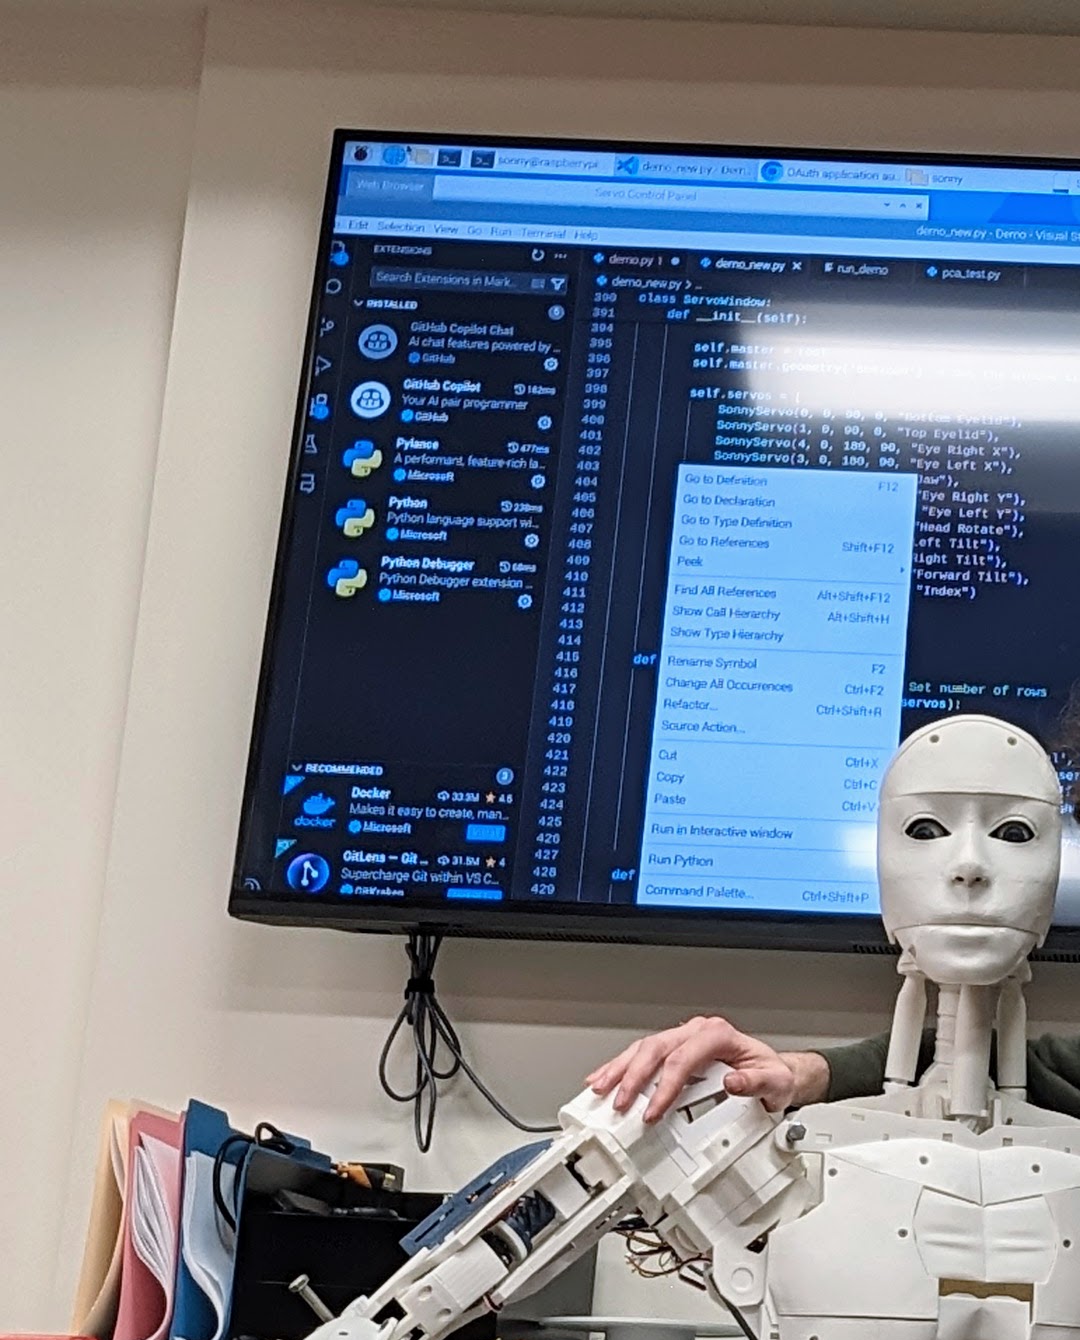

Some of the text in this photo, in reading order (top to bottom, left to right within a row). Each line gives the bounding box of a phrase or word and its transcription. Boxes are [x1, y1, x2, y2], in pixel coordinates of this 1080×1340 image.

[357, 180, 424, 191] Web Browser
[377, 221, 425, 232] Selection
[434, 224, 459, 234] View
[467, 226, 482, 235] Go
[491, 227, 512, 236] Run
[522, 227, 566, 238] Terminal
[574, 231, 598, 241] Help
[917, 226, 987, 239] demo_new.py
[996, 230, 1027, 239] Demo
[1036, 230, 1068, 241] Visual
[373, 244, 432, 255] EXTENSIONS
[609, 254, 654, 267] demo.py
[716, 258, 785, 273] demo_new.py
[837, 264, 889, 276] run_demo
[942, 267, 1001, 281] pca_test.py
[612, 275, 682, 290] demo_new.py
[367, 300, 418, 310] INSTALLED
[639, 292, 771, 307] class ServoWindow:
[667, 309, 690, 320] def
[411, 321, 514, 336] GitHub Copilot Chat
[422, 337, 445, 348] chat
[448, 338, 489, 350] features
[491, 341, 536, 353] powered
[538, 342, 551, 353] by
[403, 378, 481, 393] GitHub Copilot
[690, 387, 771, 400] self.servos
[402, 394, 528, 410] Your AI pair programmer
[396, 437, 439, 450] Pylance
[947, 444, 985, 457] Right
[408, 469, 454, 481] Microsoft
[685, 474, 767, 487] Go to Definition
[878, 481, 899, 492] F12
[389, 496, 428, 510] Python
[683, 495, 776, 507] Go to Declaration
[959, 507, 988, 519] Left
[681, 515, 792, 529] Go to Type Definition
[401, 529, 447, 541] Microsoft
[679, 535, 770, 549] Go to References
[842, 542, 894, 554] Shift+F12
[381, 556, 475, 572] Python Debugger
[677, 555, 703, 567] Peek
[379, 572, 523, 589] Python Debugger extension
[393, 588, 440, 601] Microsoft
[674, 584, 776, 598] Find All References
[817, 590, 891, 603] Alt+Shift+F12
[672, 606, 781, 621] Show Call Hierarchy
[827, 612, 889, 624] Alt+Shift+H
[670, 627, 784, 643] Show Type Hierarchy
[633, 654, 657, 665] def
[668, 656, 757, 670] Rename Symbol
[871, 664, 886, 675] F2
[665, 677, 793, 692] Change All Occurrences
[845, 684, 884, 696] Ctrl+F2
[909, 682, 1047, 697] Set number of rows
[816, 705, 882, 717] Ctrl+Shift+R
[658, 750, 677, 761] Cut
[305, 763, 383, 775] RECOMMENDED
[845, 757, 879, 769] Ctrl+X
[656, 771, 685, 784] Copy
[844, 779, 878, 790] Ctrl+C
[351, 786, 391, 799] Docker
[654, 794, 686, 805] Paste
[350, 803, 385, 815] Makes
[388, 803, 395, 816] it
[398, 807, 423, 819] easy
[426, 807, 436, 818] to
[439, 808, 474, 820] create,
[841, 801, 876, 812] Ctrl+V
[294, 815, 336, 827] docker
[363, 821, 412, 834] Microsoft
[652, 824, 793, 840] Run in Interactive window
[343, 850, 386, 863] GitLens
[648, 854, 714, 868] Run Python
[611, 869, 636, 881] def
[645, 884, 704, 897] Command
[802, 890, 869, 903] Ctrl+Shift+P
